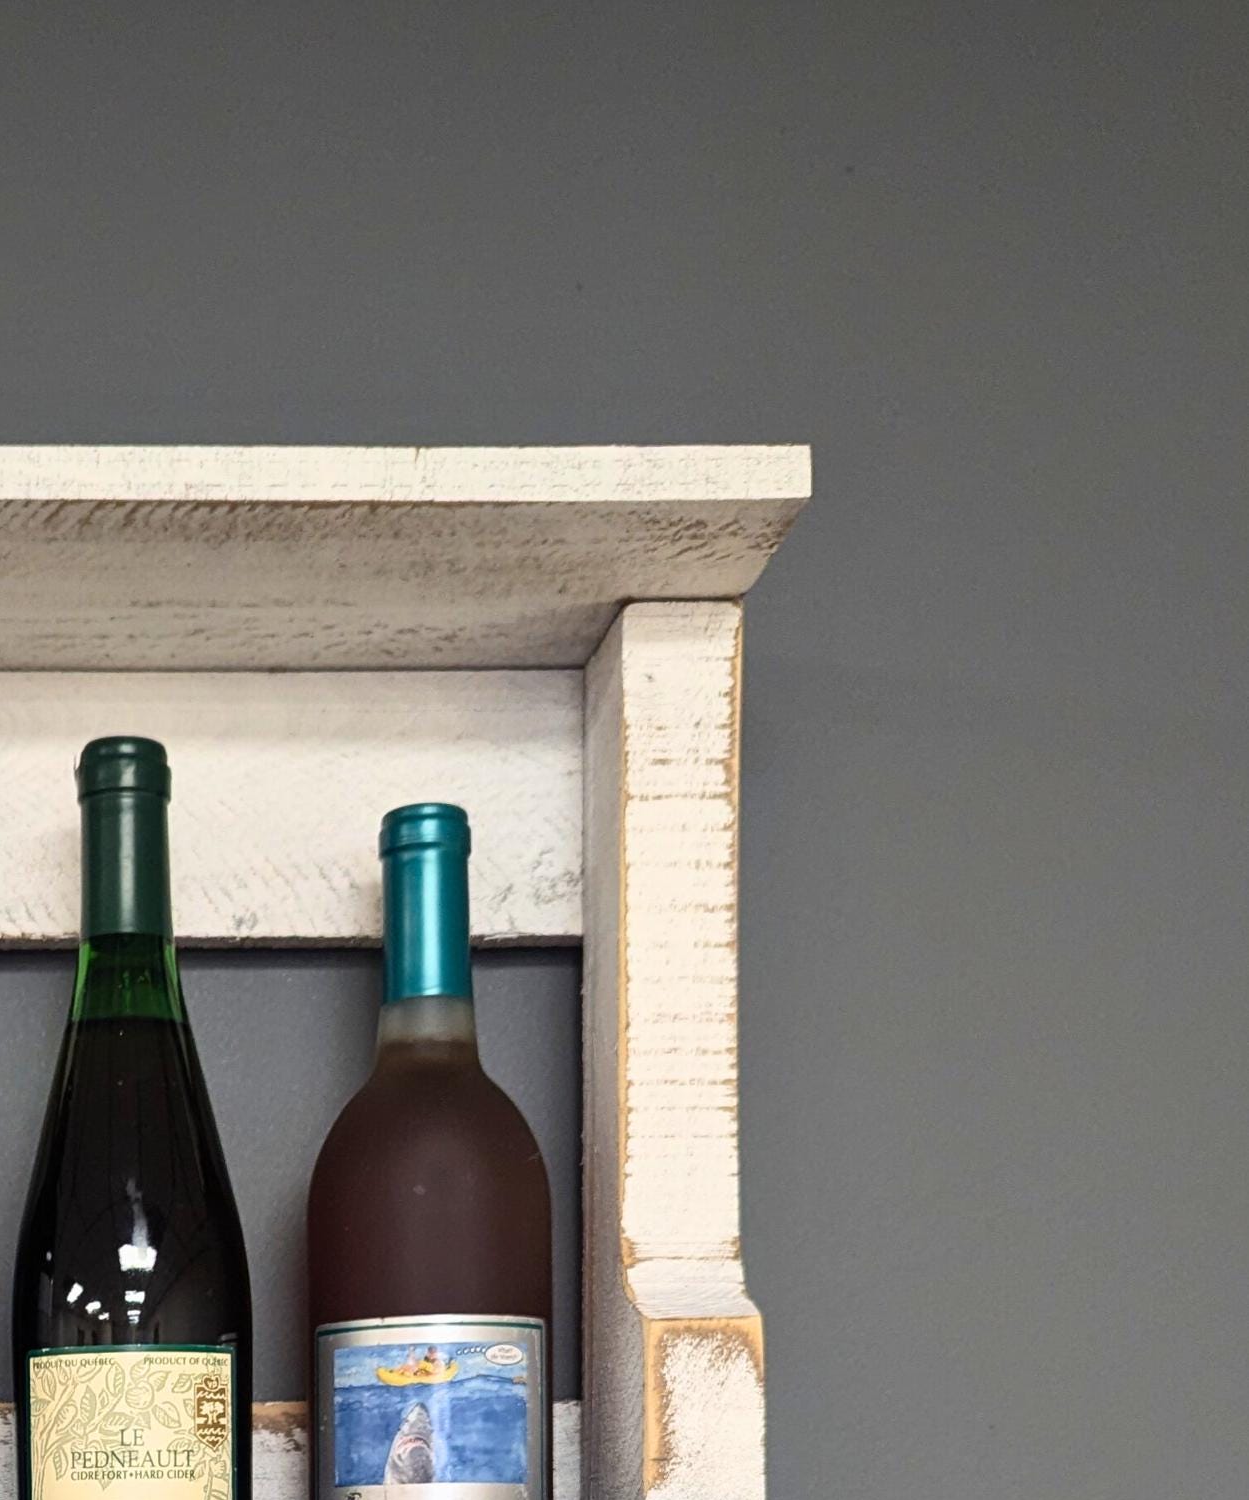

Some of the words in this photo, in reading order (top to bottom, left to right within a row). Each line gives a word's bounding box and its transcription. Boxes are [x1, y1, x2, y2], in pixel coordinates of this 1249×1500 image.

[143, 1356, 187, 1366] PRODUCT
[188, 1356, 200, 1366] OF
[119, 1427, 146, 1447] LE
[70, 1449, 195, 1469] PEDNEAULT
[70, 1470, 100, 1481] CIDRE
[101, 1470, 129, 1481] FORT
[134, 1469, 165, 1480] HARD
[166, 1469, 196, 1481] CIDER
